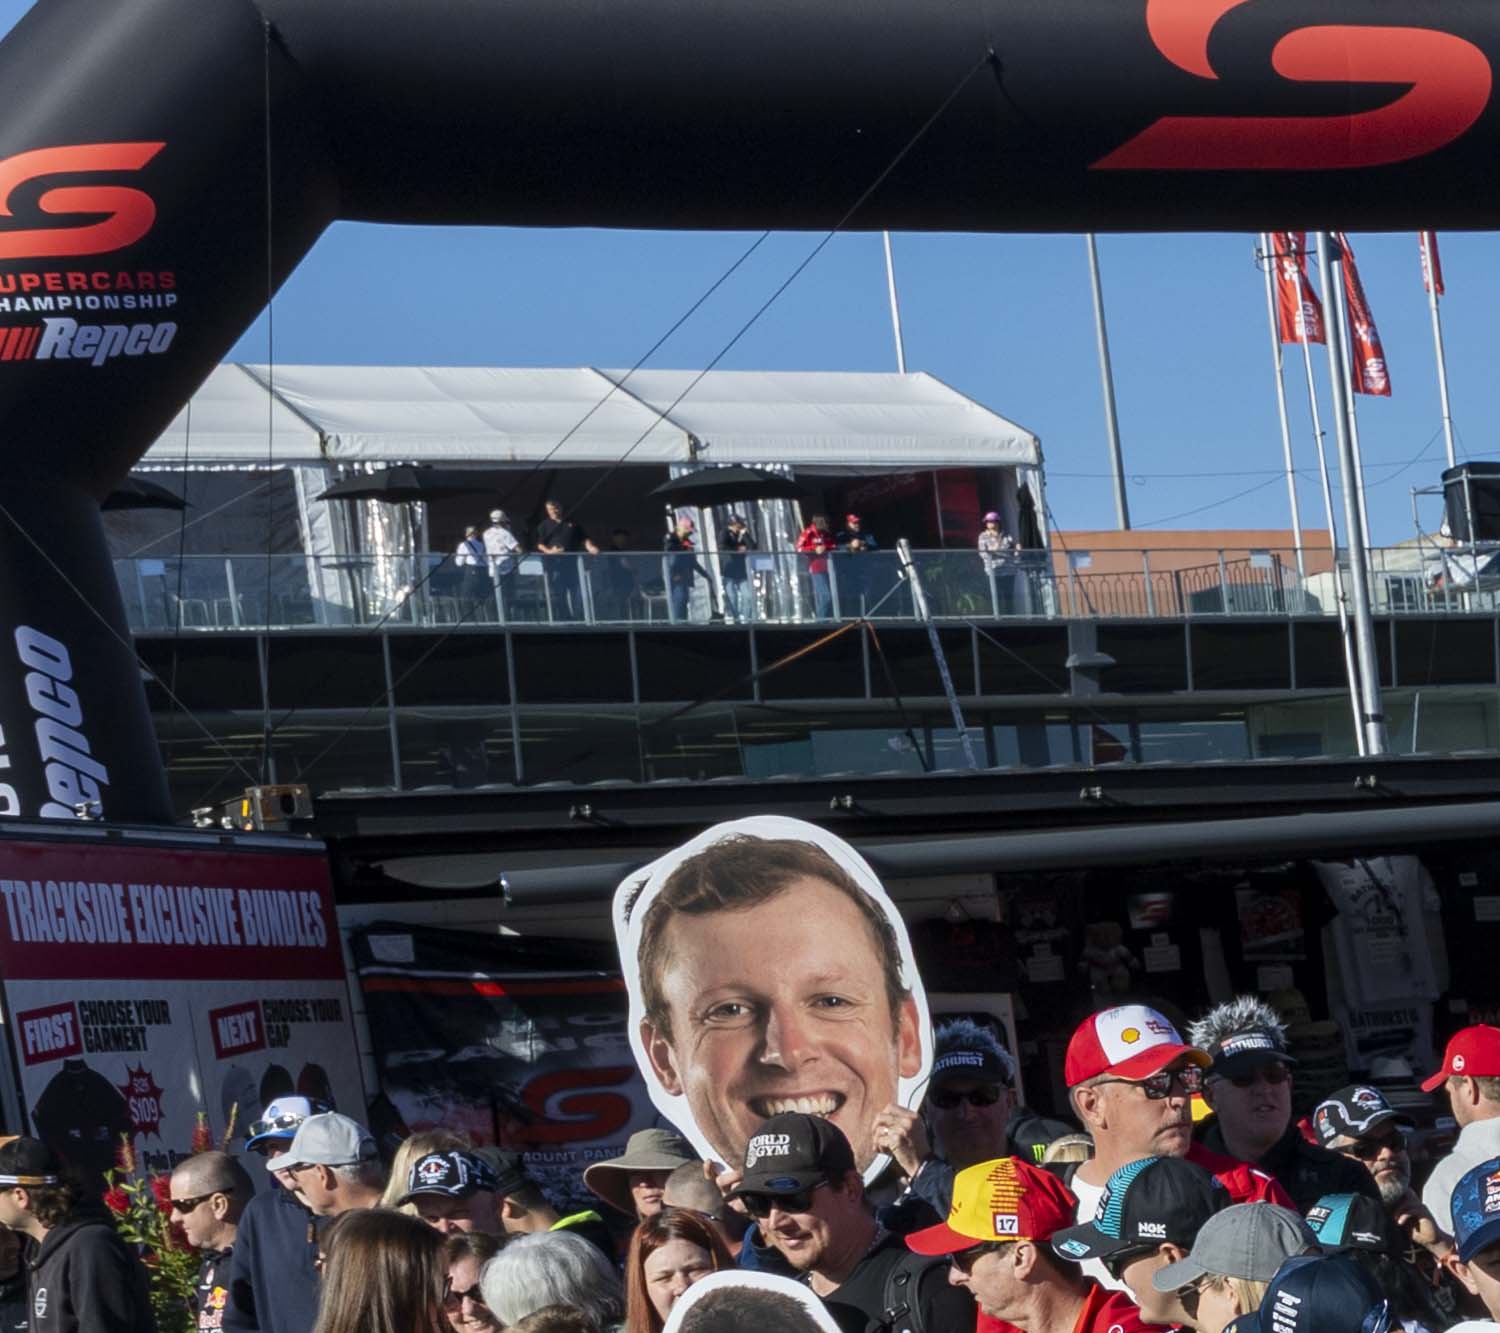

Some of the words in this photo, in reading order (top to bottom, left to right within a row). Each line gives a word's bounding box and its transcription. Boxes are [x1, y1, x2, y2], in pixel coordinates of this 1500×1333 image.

[0, 271, 176, 292] UPERCARS
[0, 294, 178, 312] HAMPIONSHIP
[35, 317, 178, 366] Repco
[15, 625, 109, 818] epco
[2, 880, 132, 943] TRACKSIDE
[127, 882, 241, 945] EXCLUSIVE
[238, 888, 327, 947] BUNDLES
[23, 1011, 76, 1055] FIRST
[81, 1000, 132, 1025] CHOOSE
[132, 1001, 170, 1024] YOUR
[218, 1011, 257, 1049] NEXT
[263, 1000, 310, 1022] CHOOSE
[311, 1001, 344, 1023] YOUR
[82, 1026, 147, 1053] GARMENT
[756, 1145, 790, 1157] GYM
[998, 1215, 1017, 1232] 17
[1138, 1222, 1167, 1234] NGK
